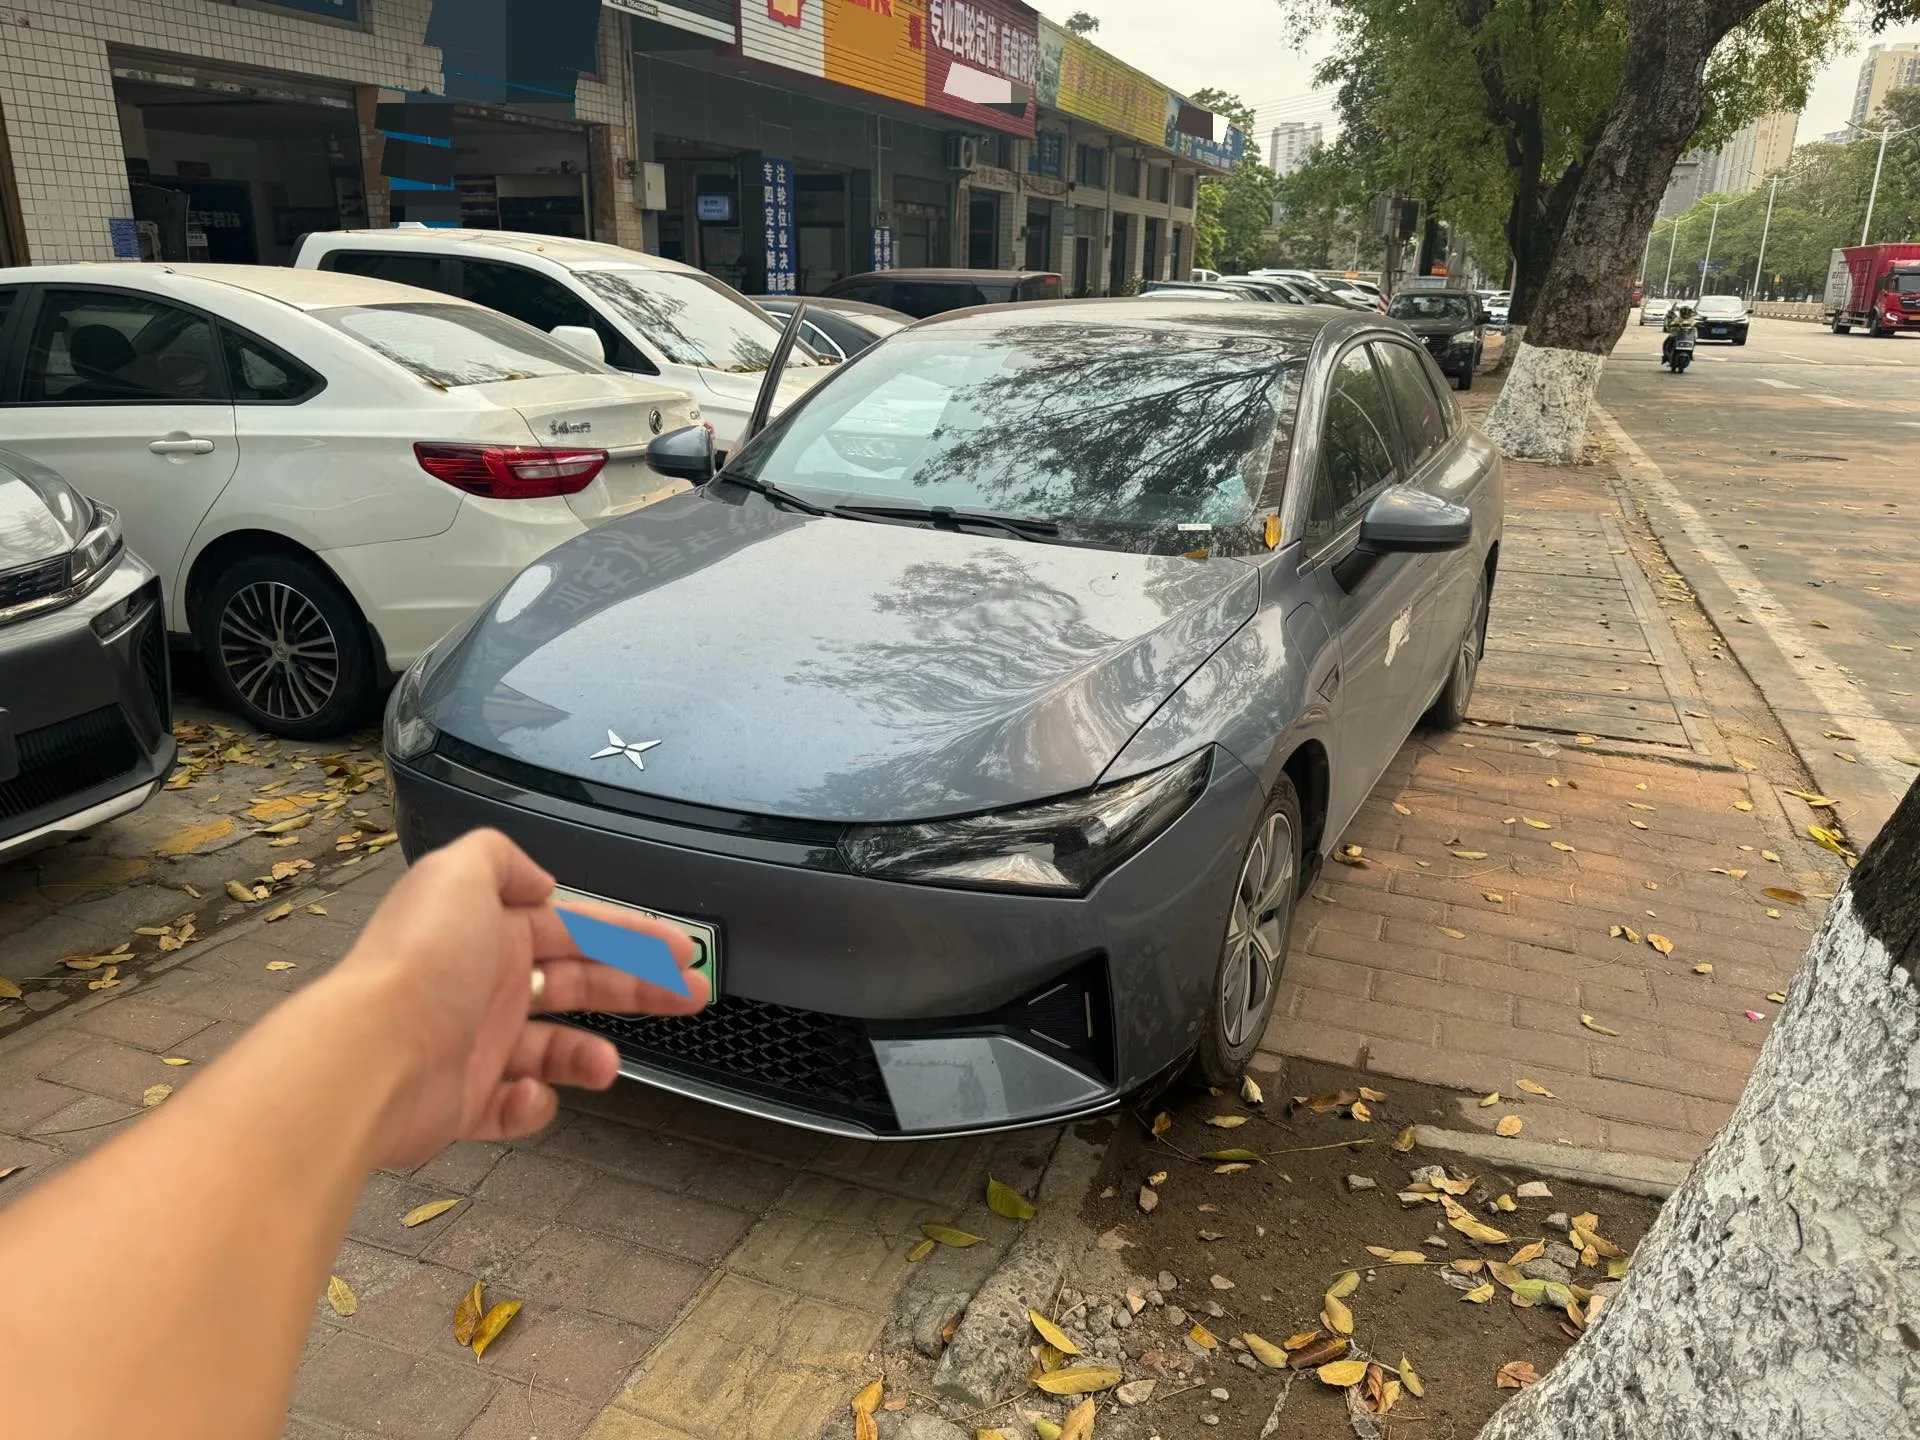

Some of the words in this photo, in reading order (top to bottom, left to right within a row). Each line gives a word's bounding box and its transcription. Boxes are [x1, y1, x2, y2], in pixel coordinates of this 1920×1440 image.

[930, 0, 997, 69] 专业四轮定位
[763, 162, 786, 183] 专注
[764, 186, 787, 205] 四轮
[765, 228, 788, 248] 专业
[766, 250, 789, 270] 解决
[767, 272, 796, 292] 新能源
